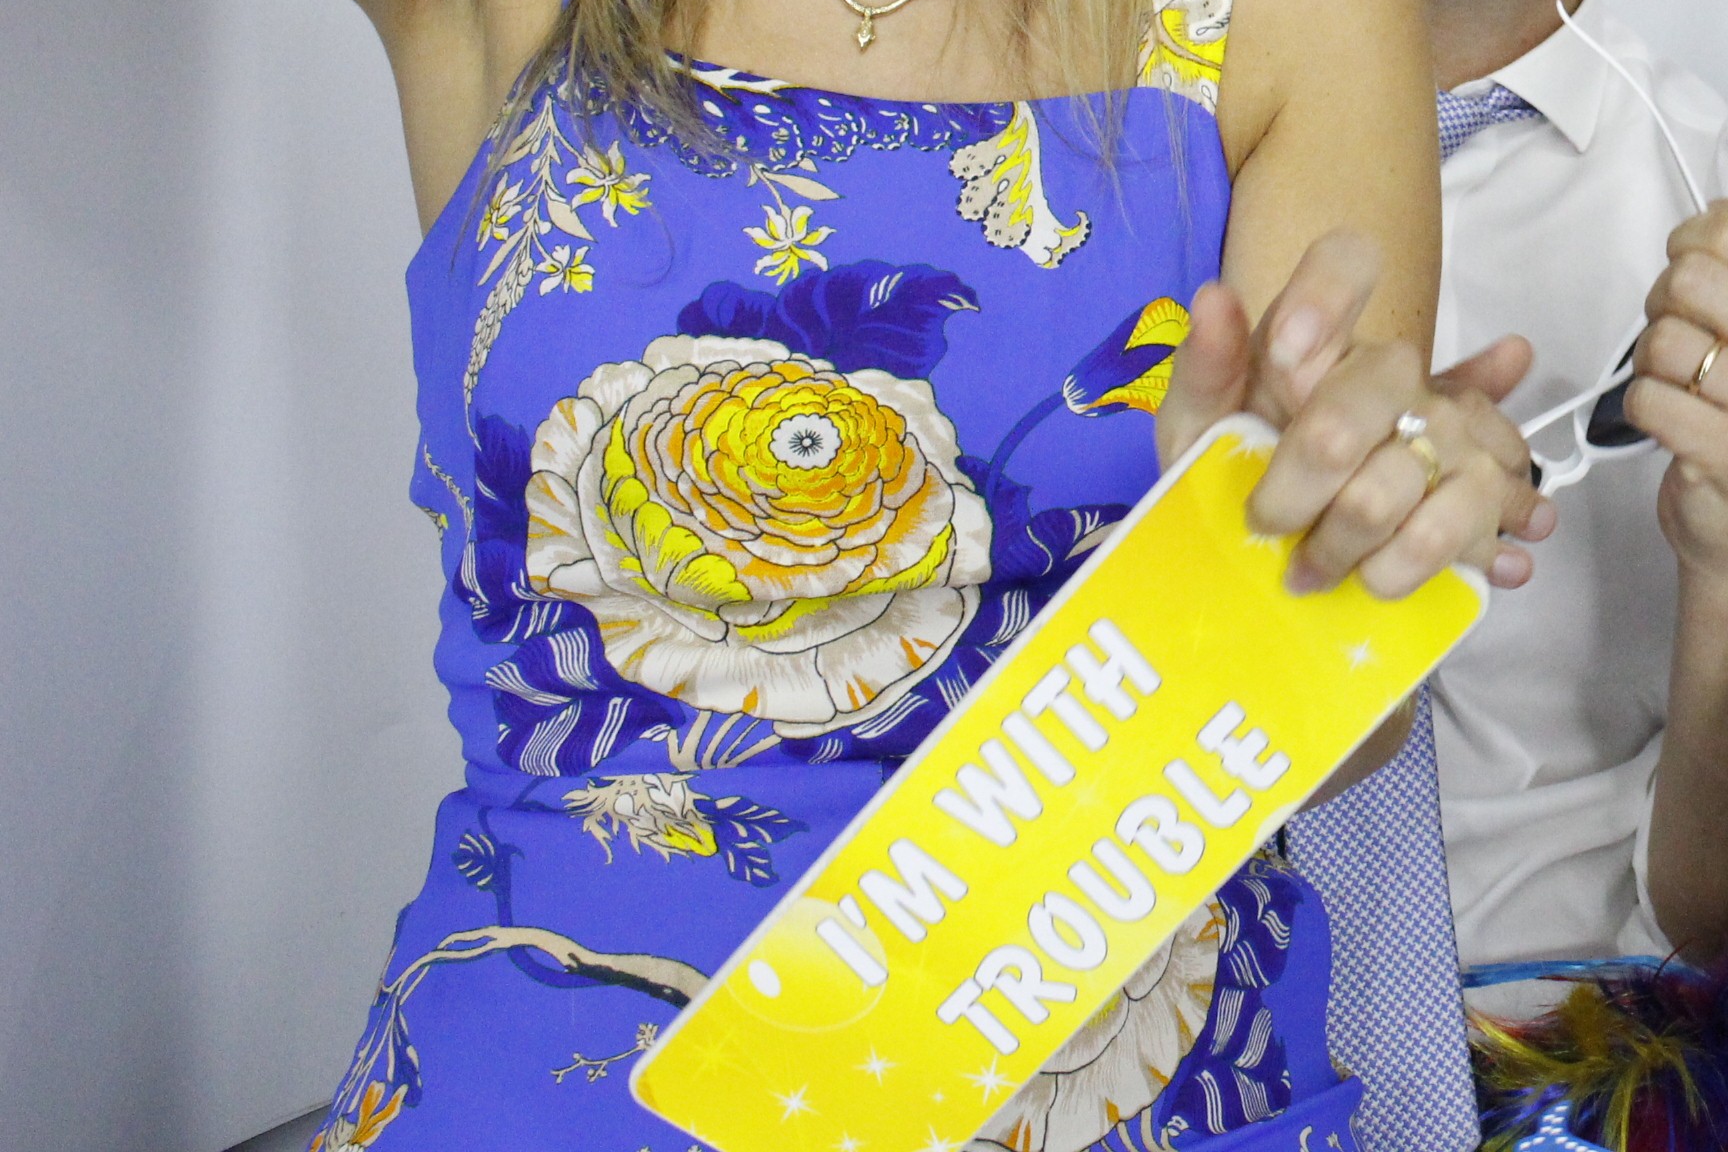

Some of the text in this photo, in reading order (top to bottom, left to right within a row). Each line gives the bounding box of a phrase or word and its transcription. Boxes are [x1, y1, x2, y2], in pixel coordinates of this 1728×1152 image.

[815, 618, 1162, 988] I'M WITH
[936, 702, 1291, 1056] TROUBLE
